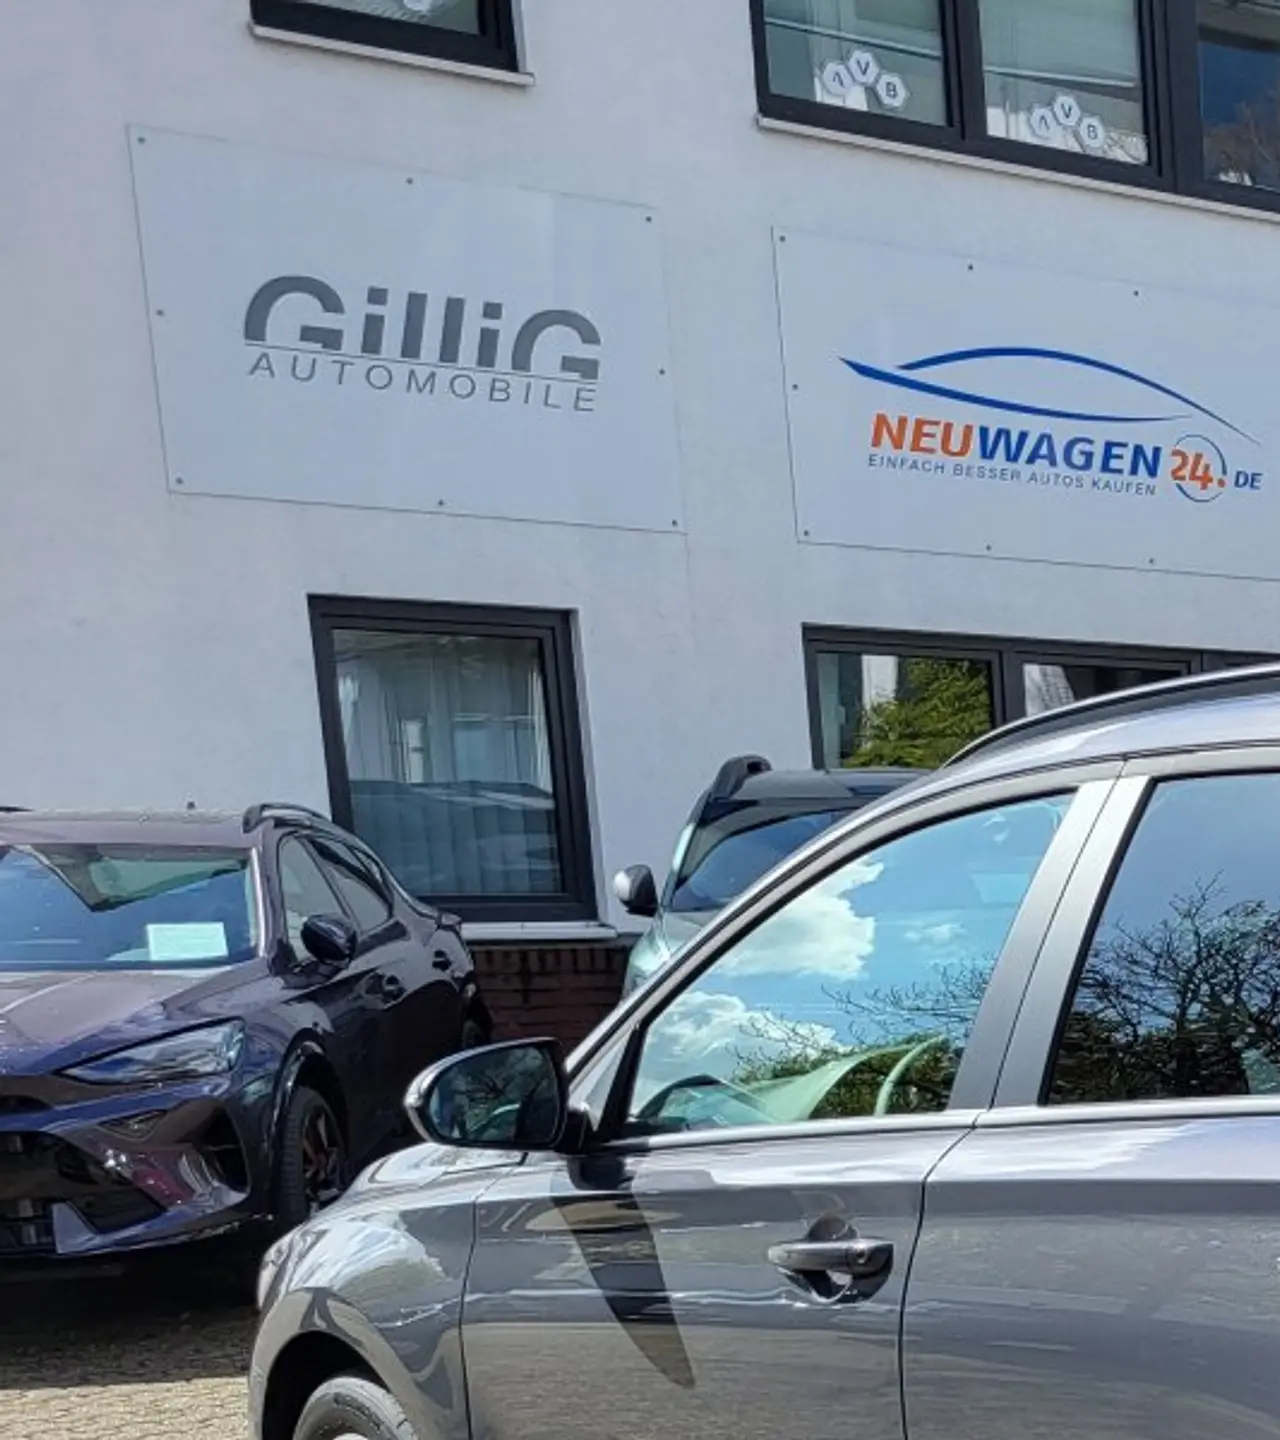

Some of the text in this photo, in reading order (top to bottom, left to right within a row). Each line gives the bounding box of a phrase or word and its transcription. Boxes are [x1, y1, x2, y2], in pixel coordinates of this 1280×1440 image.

[248, 352, 597, 412] AUTOMOBILE
[867, 453, 1157, 496] EINFACH BESSER AUTOS KAUFEN
